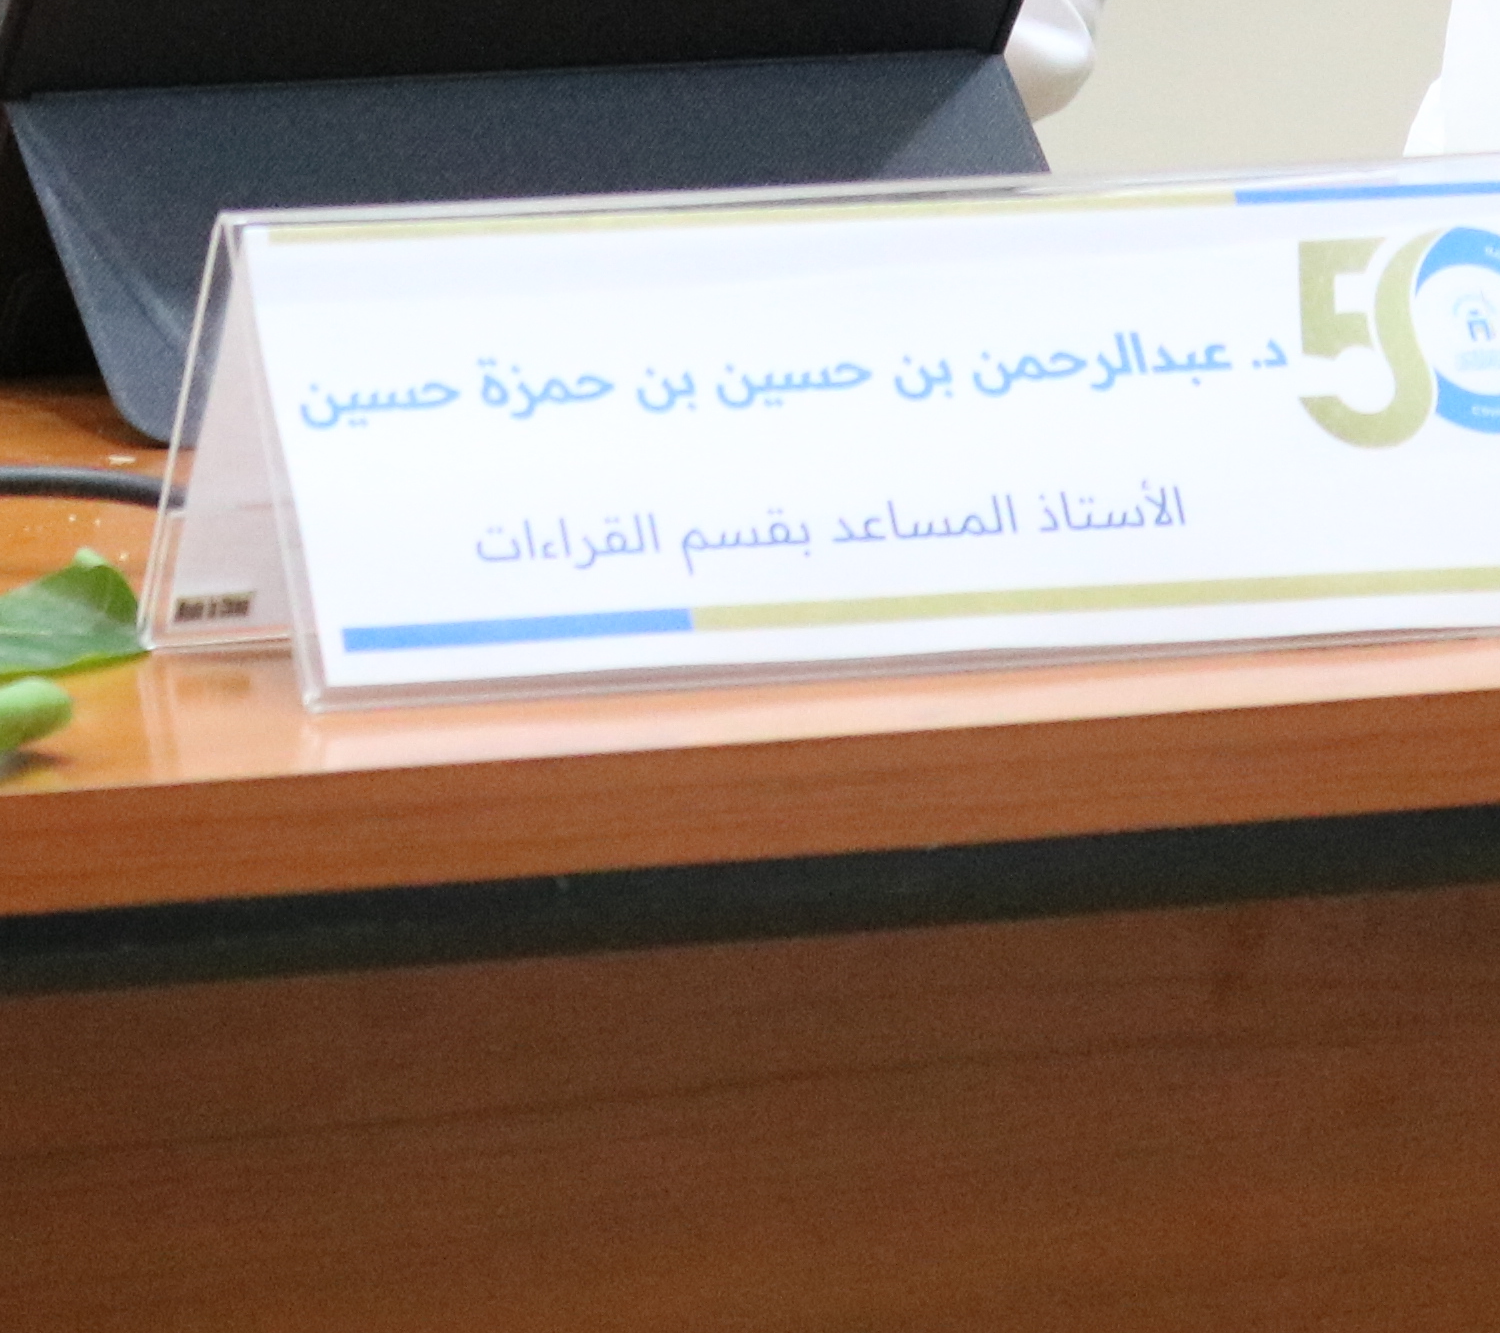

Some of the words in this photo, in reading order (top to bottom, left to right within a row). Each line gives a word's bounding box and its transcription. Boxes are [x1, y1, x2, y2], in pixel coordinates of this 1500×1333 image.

[479, 358, 615, 420] حمزة
[715, 361, 873, 410] حسين
[893, 355, 953, 401] بن
[972, 331, 1233, 399] عبدالرحمن
[300, 380, 461, 430] حسين
[636, 370, 696, 414] بن
[832, 494, 1018, 544] المساعد
[1038, 481, 1187, 533] الأستاذ
[475, 512, 661, 571] القراءات
[681, 508, 812, 575] بقسم
